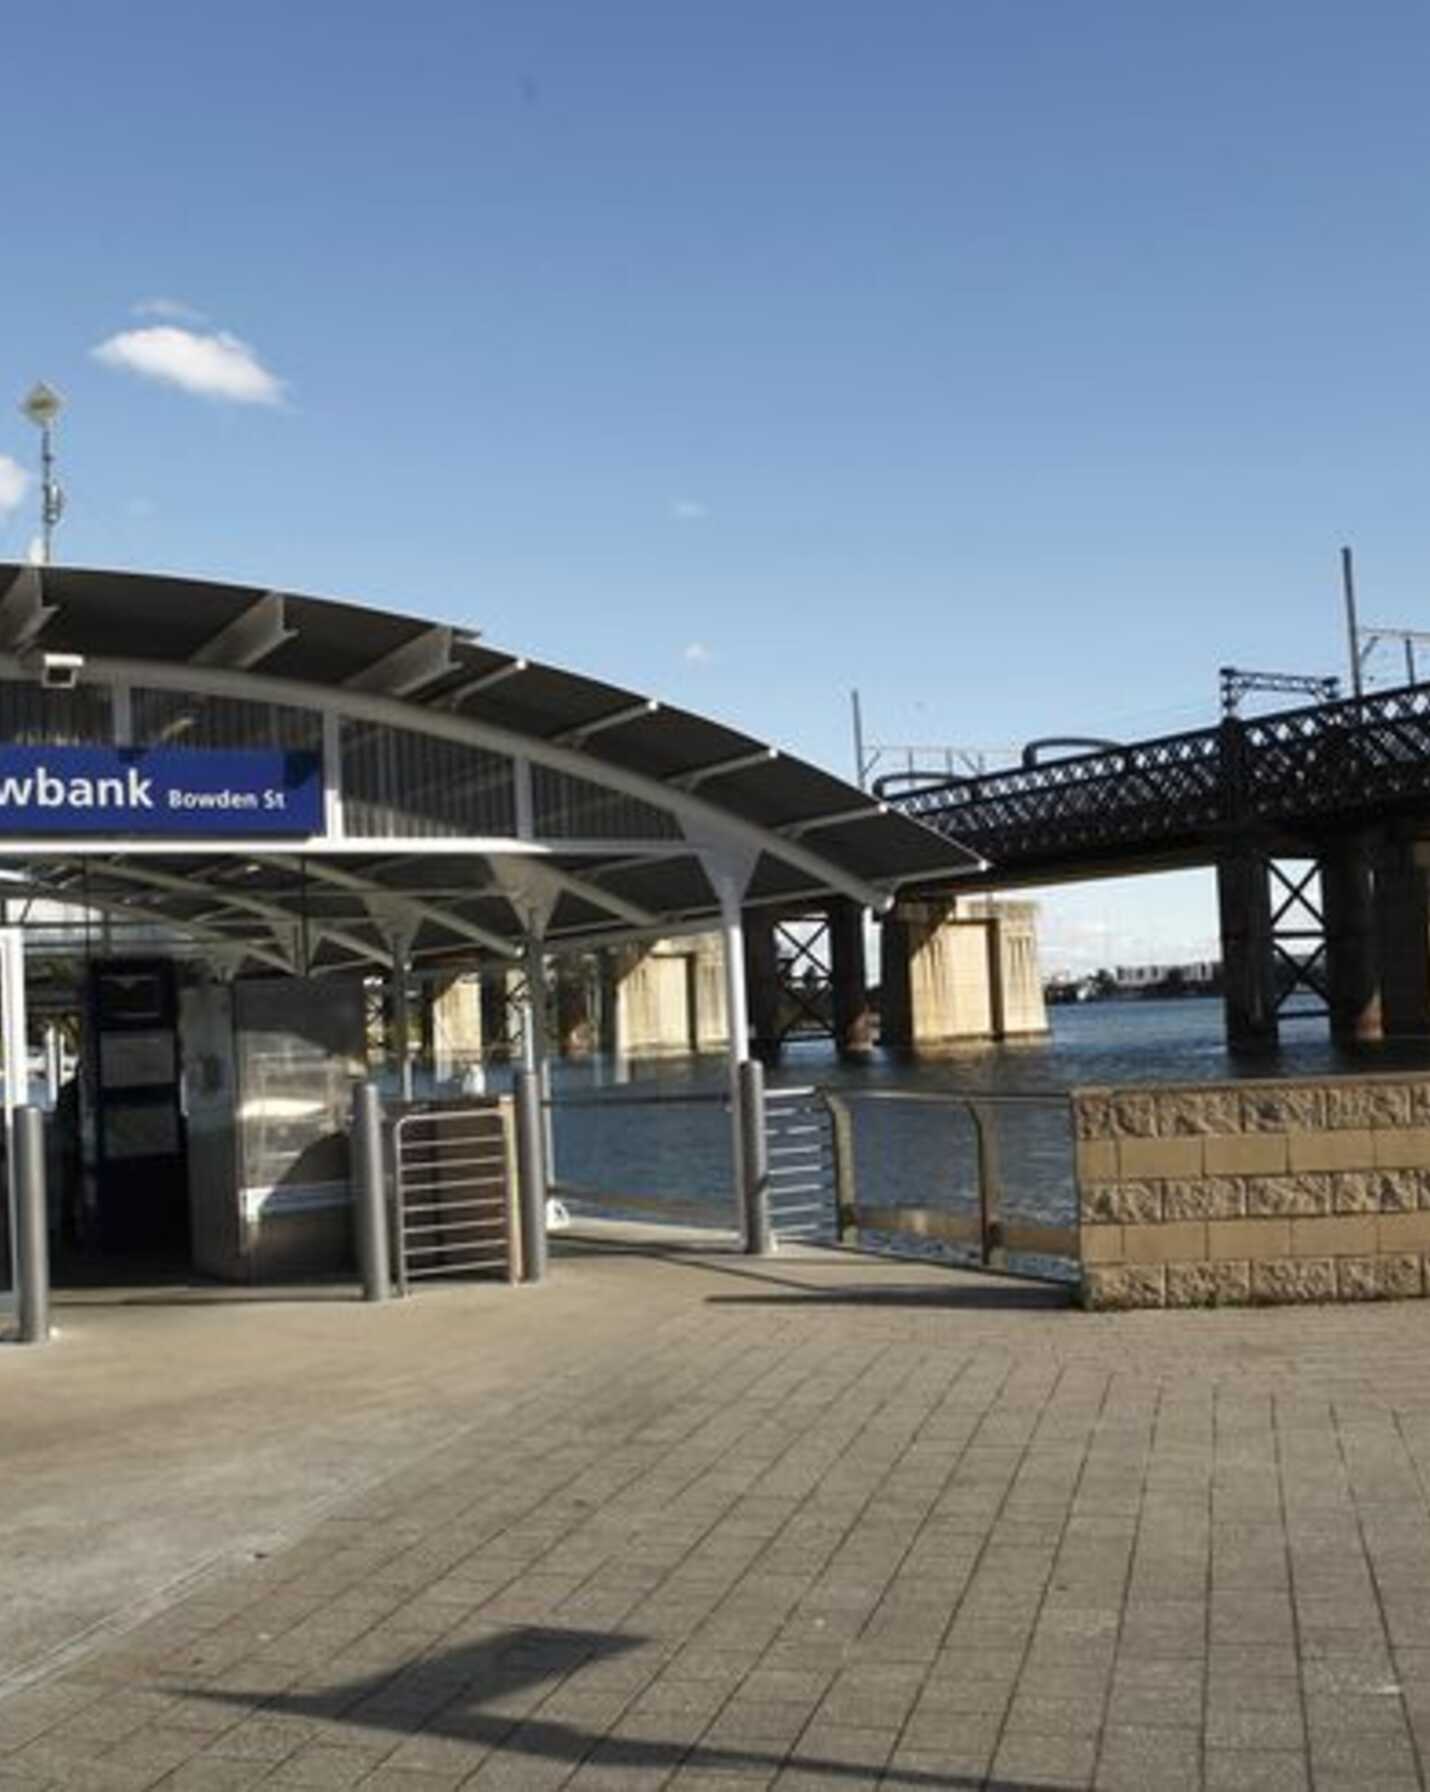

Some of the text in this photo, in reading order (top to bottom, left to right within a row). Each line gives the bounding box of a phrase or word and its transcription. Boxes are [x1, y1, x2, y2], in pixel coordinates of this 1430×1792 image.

[0, 766, 285, 809] wbank Bowden St
